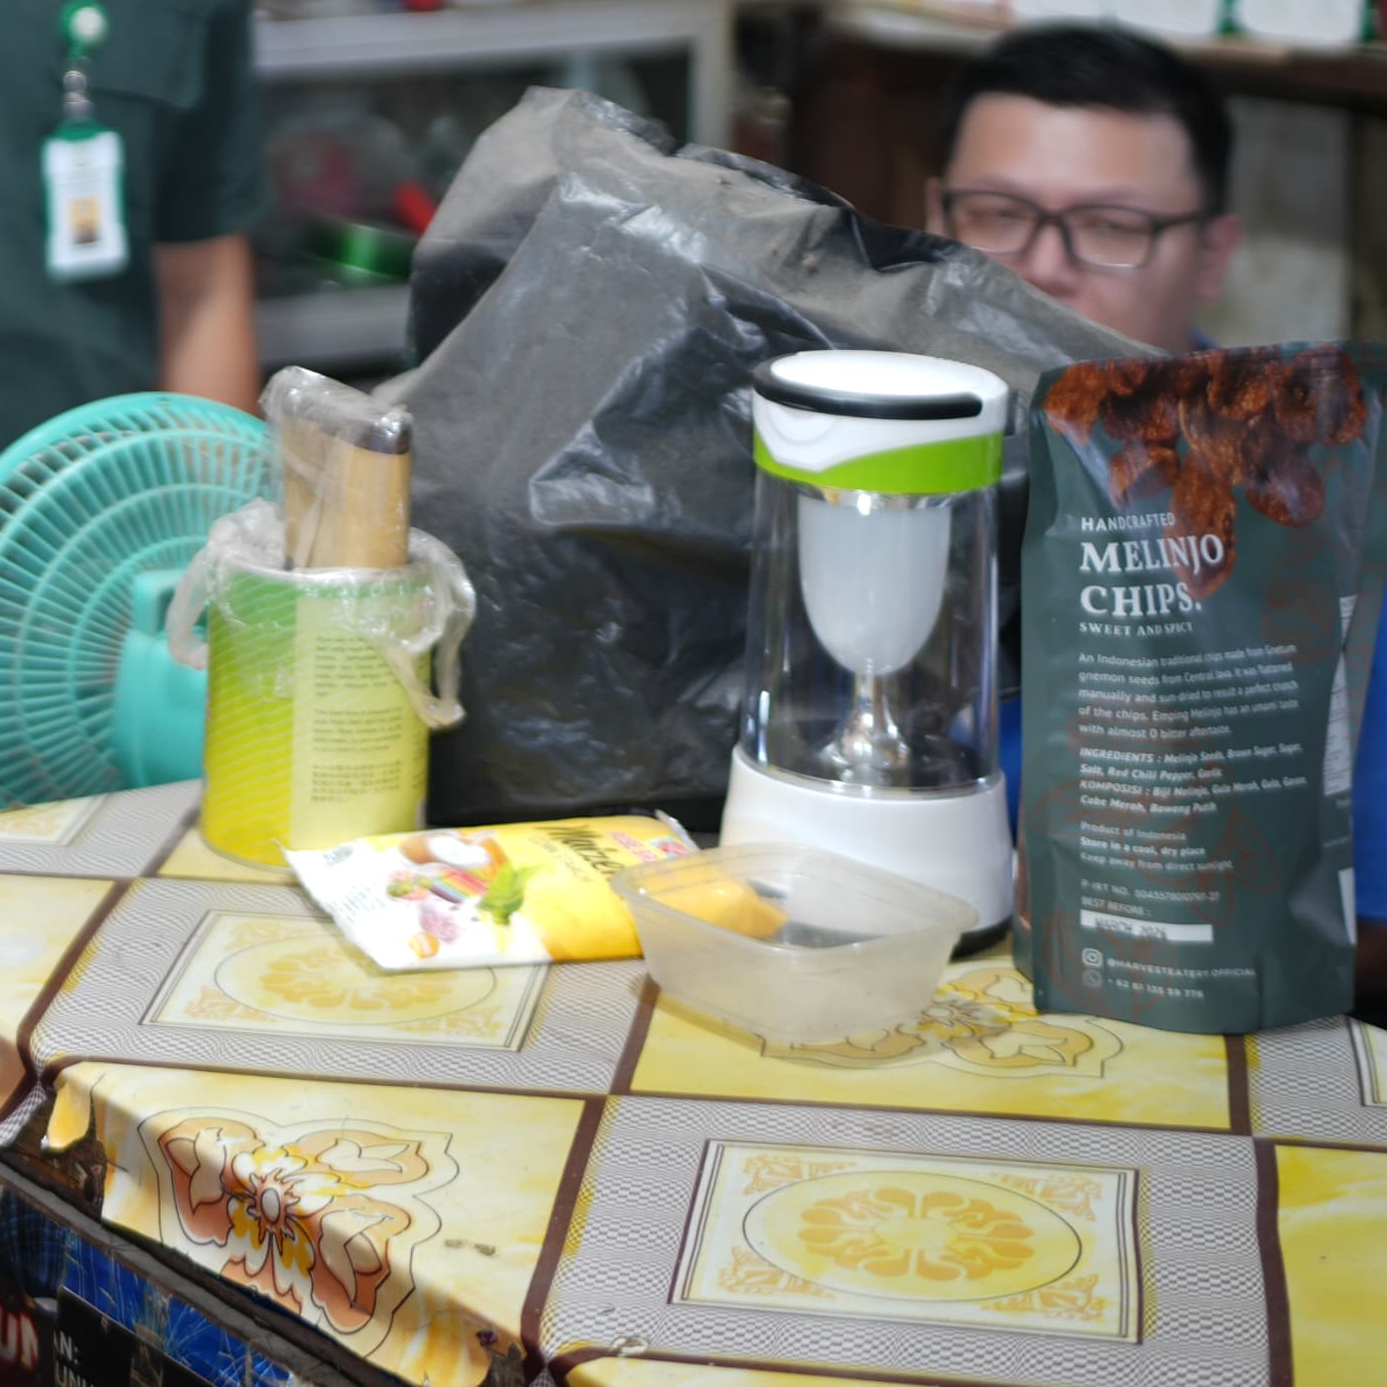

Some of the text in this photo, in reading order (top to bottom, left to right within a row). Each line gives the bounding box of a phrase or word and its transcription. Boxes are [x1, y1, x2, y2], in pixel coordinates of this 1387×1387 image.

[1081, 512, 1177, 532] HANDCRAFTED
[1079, 533, 1225, 576] MELINJO
[1079, 581, 1203, 618] CHIPS.
[1079, 621, 1194, 637] SWEET AND SPICY
[1078, 652, 1095, 663] An
[1097, 653, 1159, 668] Indonesian
[1128, 675, 1160, 686] seeds
[1078, 689, 1132, 704] manually
[1134, 693, 1157, 703] and
[1078, 705, 1092, 716] of
[1093, 707, 1114, 718] the
[1078, 724, 1105, 734] with
[1107, 725, 1147, 739] almost
[1079, 747, 1155, 763] INGREDIENTS
[1107, 766, 1129, 777] Red
[1080, 821, 1120, 836] Product
[1136, 829, 1187, 842] Indonesia
[1080, 836, 1108, 850] Store
[1110, 840, 1121, 851] in
[1180, 846, 1206, 857] place
